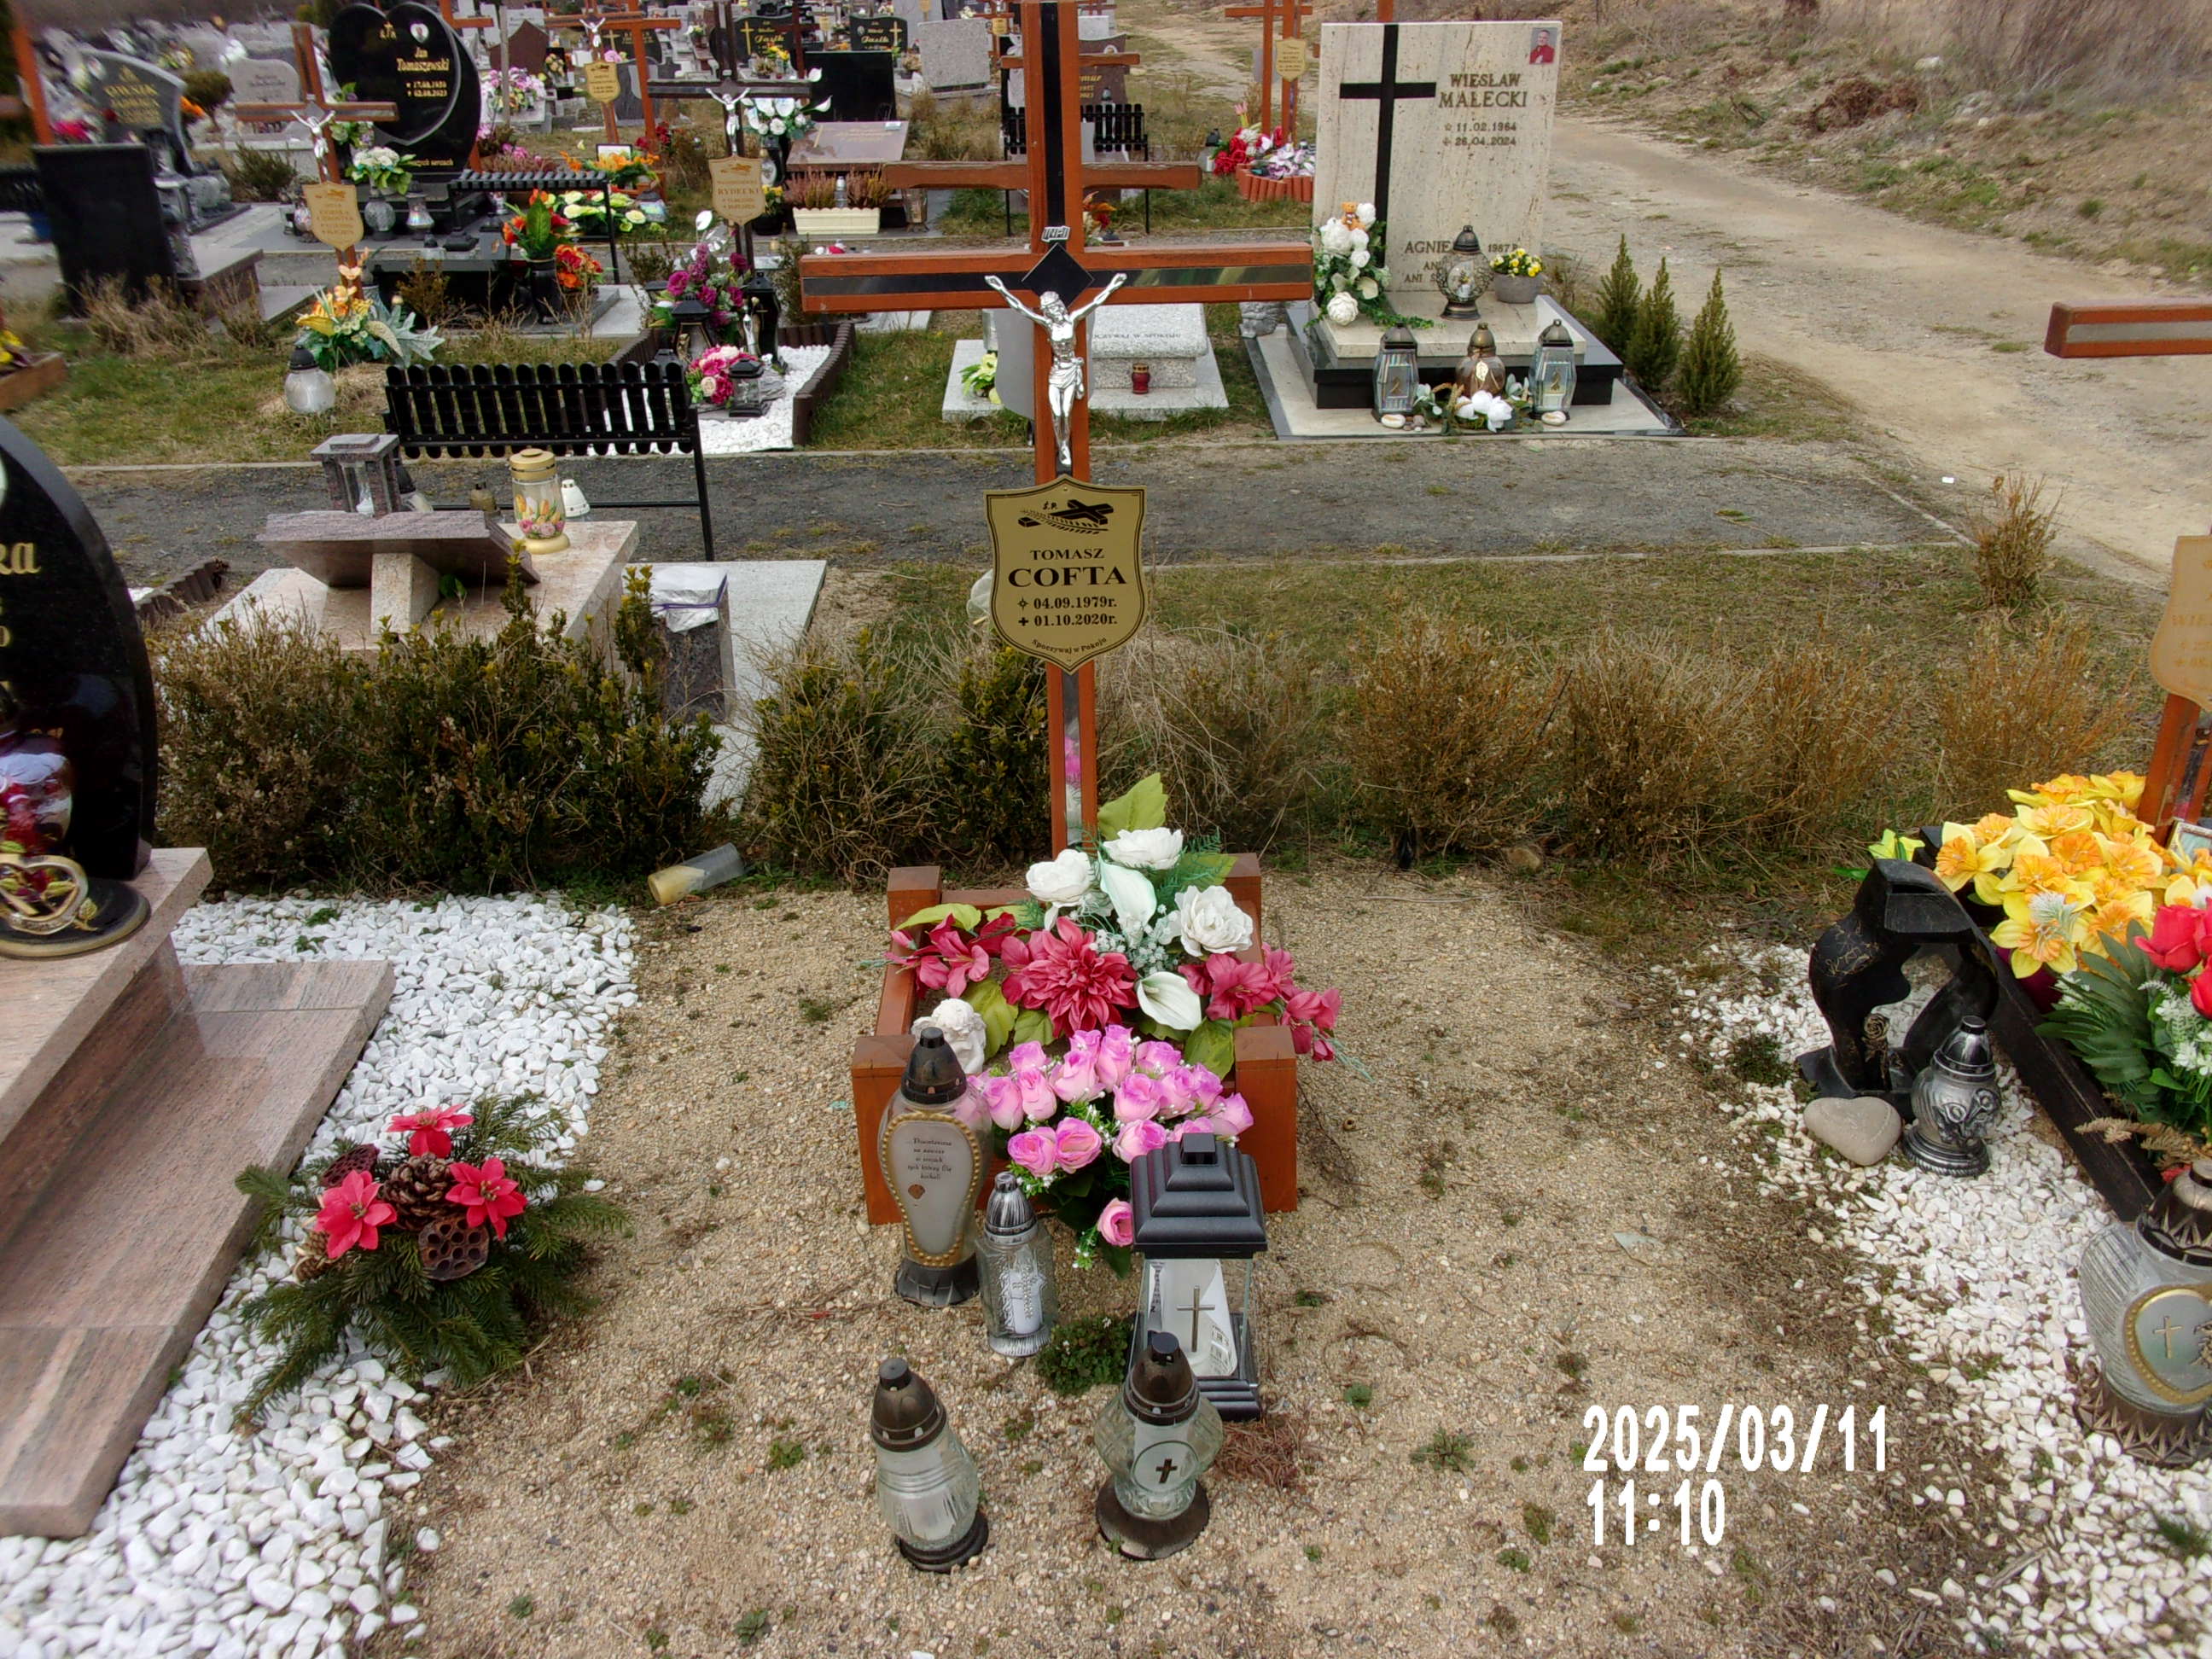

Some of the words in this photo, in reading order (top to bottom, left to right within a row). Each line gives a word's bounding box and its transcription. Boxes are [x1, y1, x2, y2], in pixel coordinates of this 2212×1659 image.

[1449, 73, 1522, 87] WIESŁAW
[1438, 90, 1528, 108] MAŁECKI
[1404, 240, 1451, 254] AGNIE
[1030, 548, 1105, 561] TOMASZ
[1008, 566, 1127, 588] COFTA
[1033, 596, 1118, 610] 04.09.1979r.
[1033, 613, 1118, 627] 01.10.2020r.
